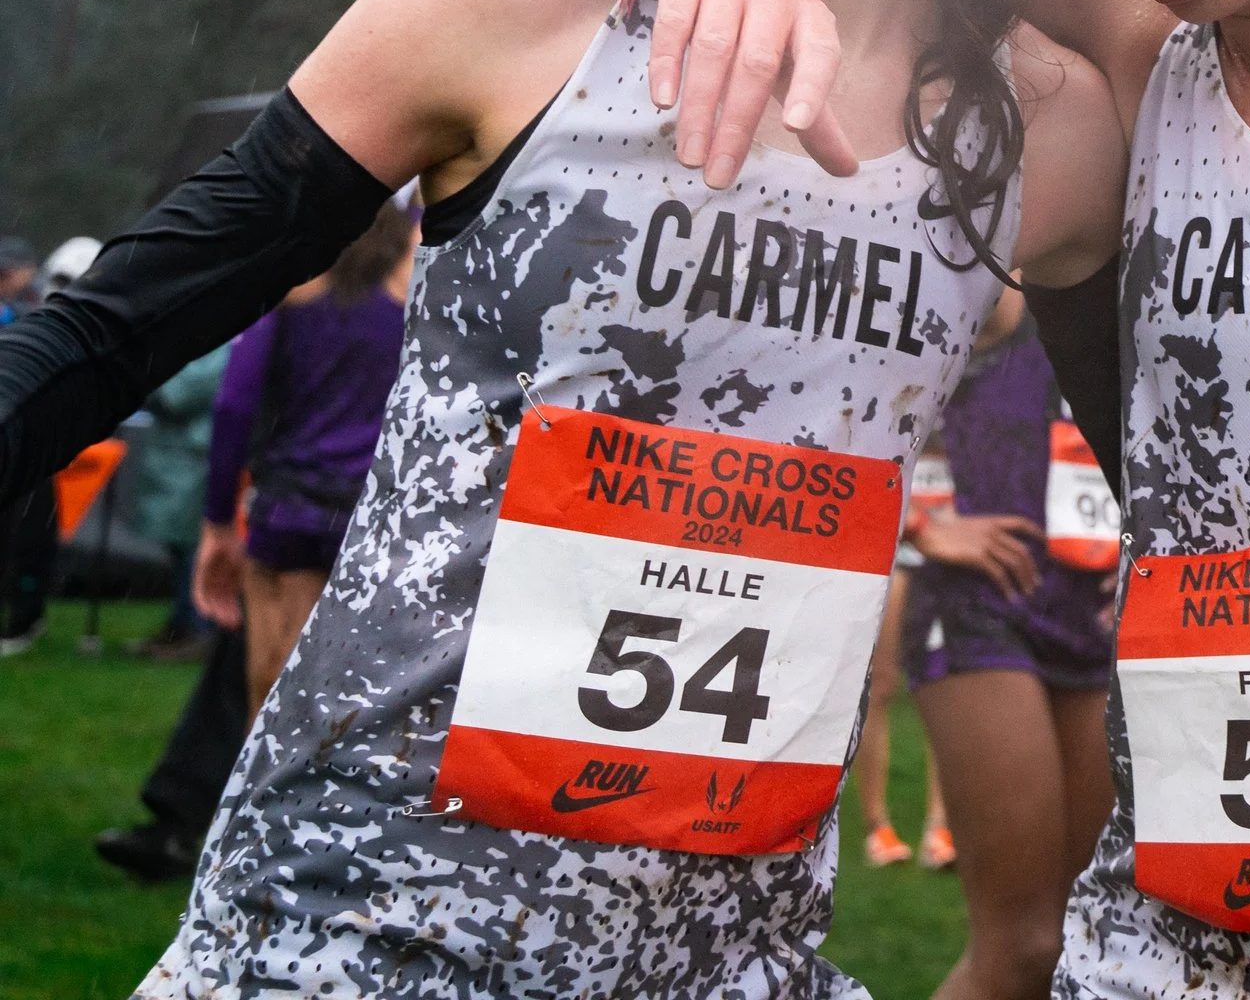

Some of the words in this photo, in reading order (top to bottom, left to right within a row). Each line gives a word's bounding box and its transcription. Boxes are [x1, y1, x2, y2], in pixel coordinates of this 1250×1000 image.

[636, 200, 924, 357] CARMEL
[586, 426, 697, 475] NIKE
[711, 448, 857, 500] CROSS
[587, 467, 840, 537] NATIONALS
[682, 521, 743, 547] 2024
[640, 560, 764, 600] HALLE
[578, 609, 770, 745] 54
[573, 759, 650, 794] RUN
[691, 819, 742, 834] USATF
